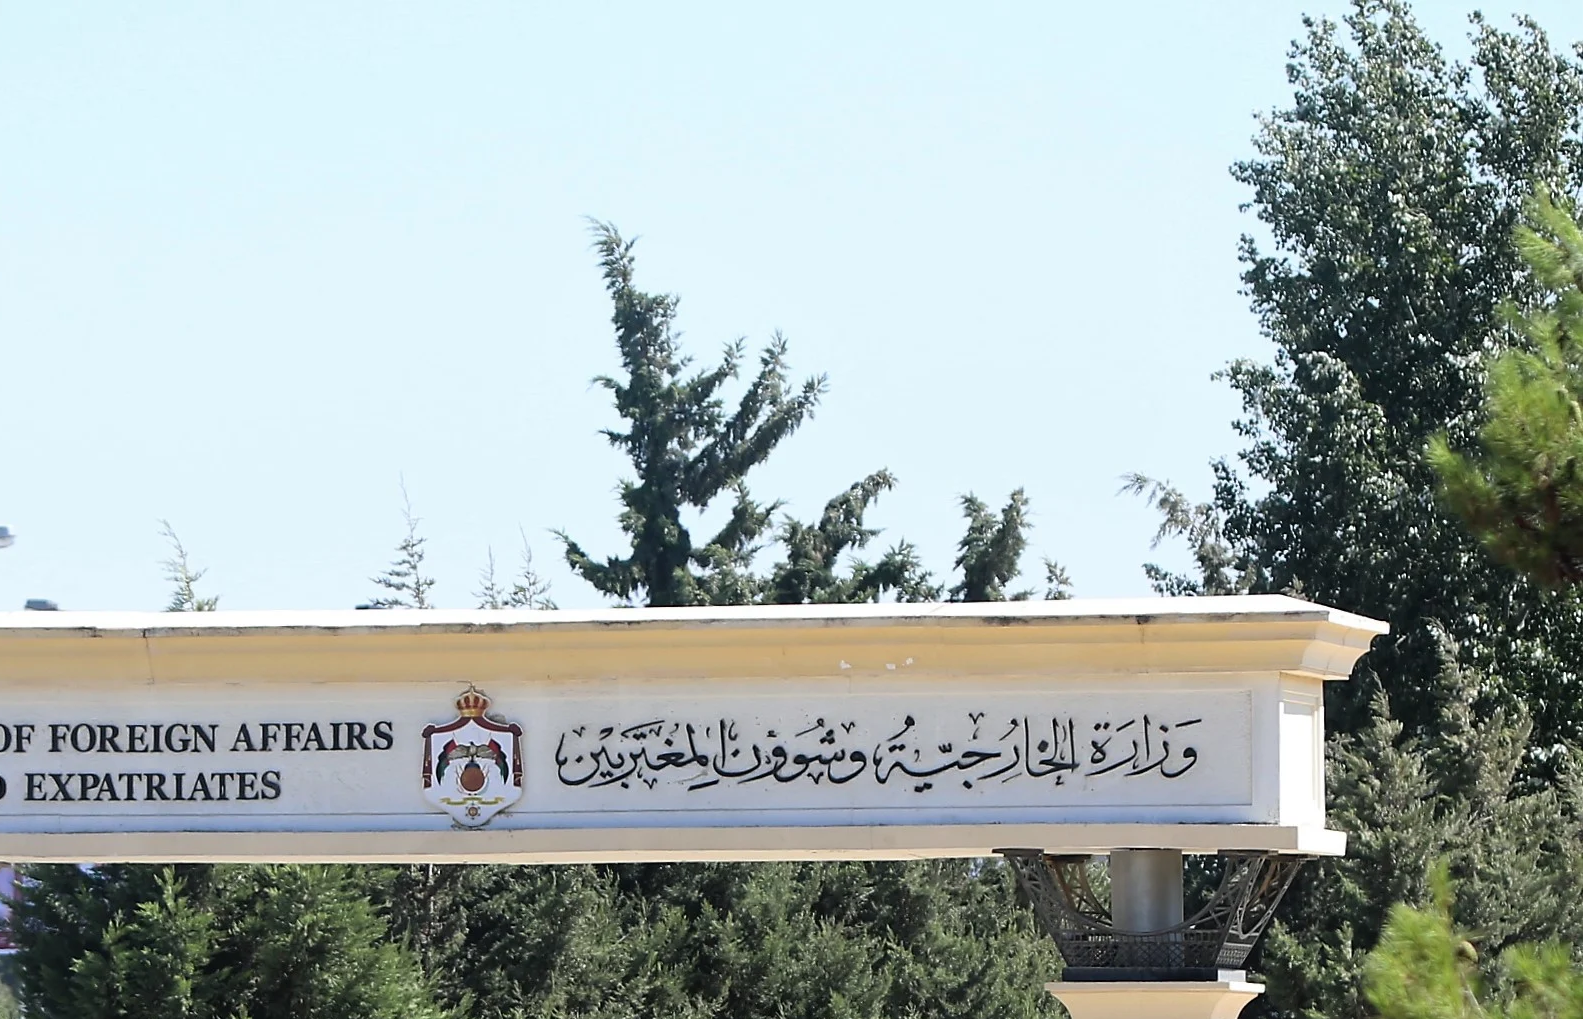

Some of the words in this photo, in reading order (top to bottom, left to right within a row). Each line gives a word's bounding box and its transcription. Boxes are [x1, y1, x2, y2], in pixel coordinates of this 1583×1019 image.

[48, 723, 219, 753] FOREIGN
[229, 720, 395, 753] AFFAIRS
[23, 770, 282, 802] EXPATRIATES
